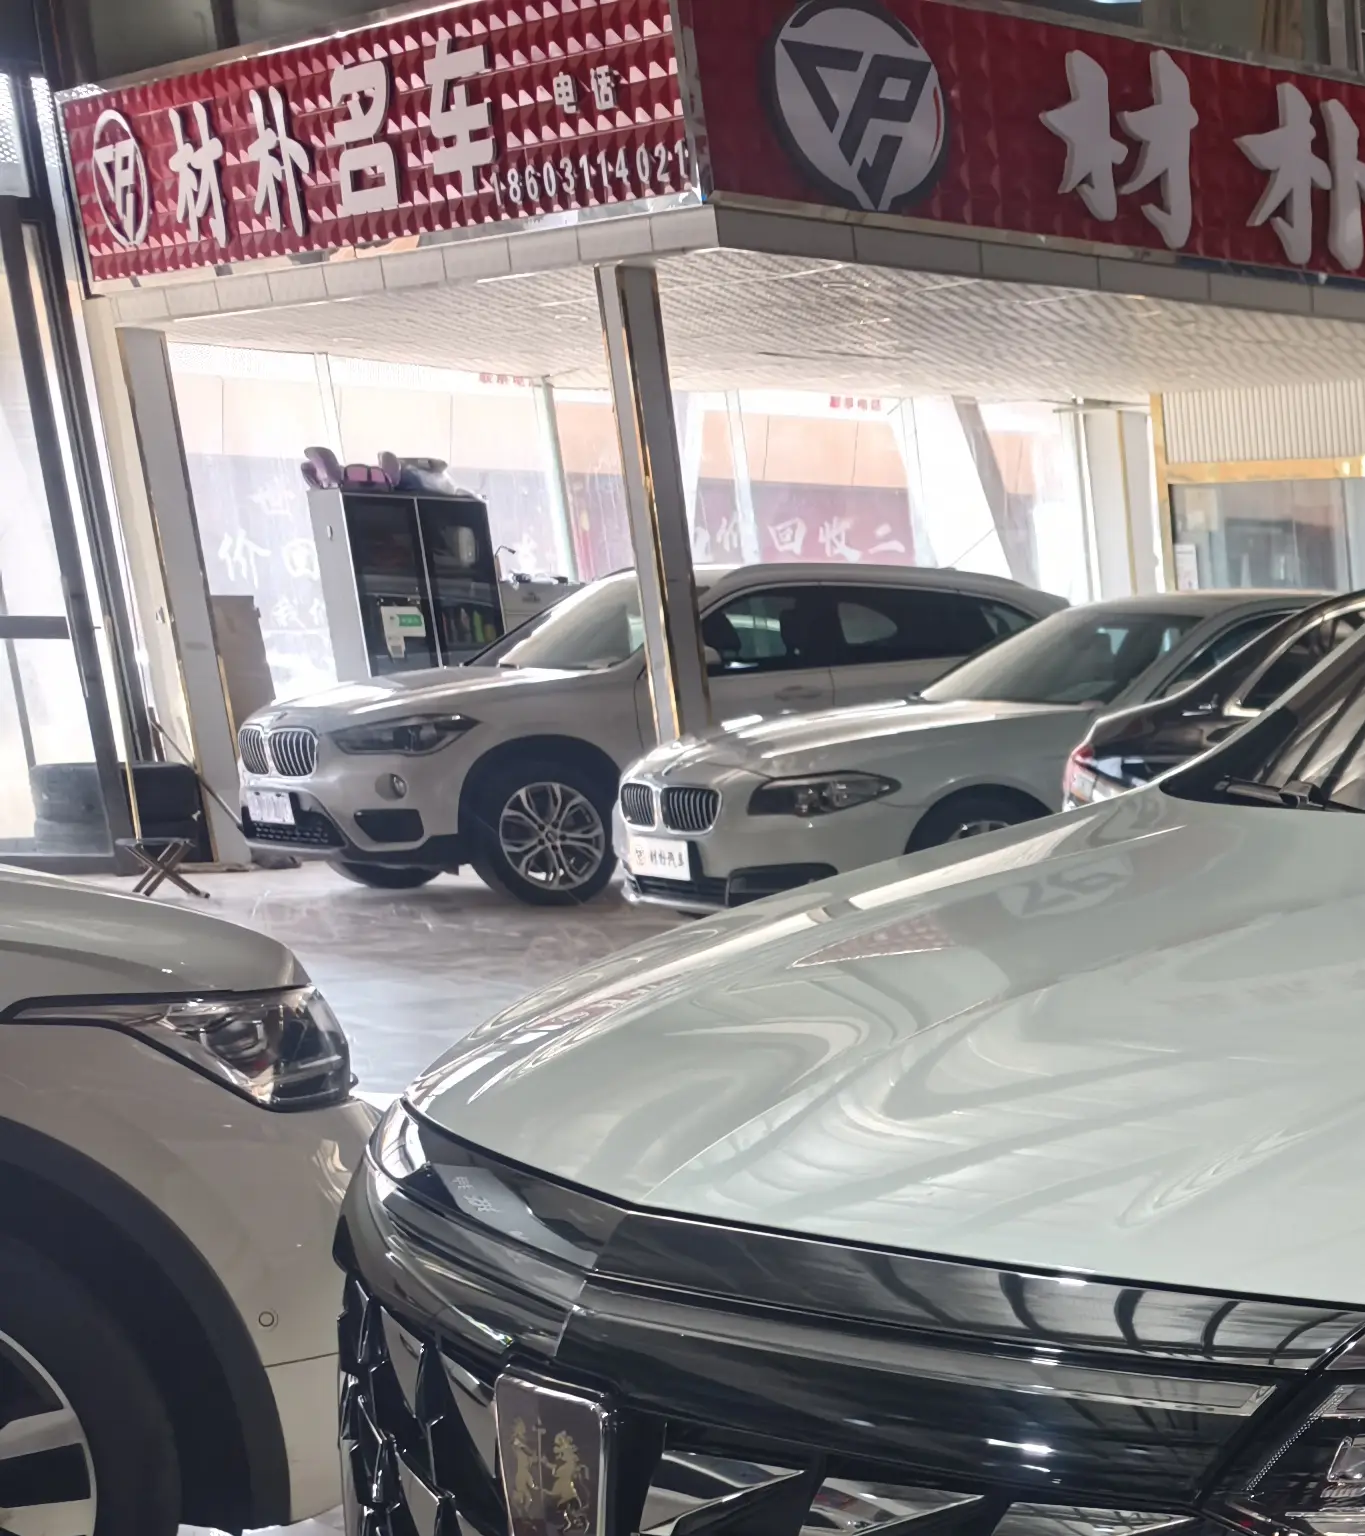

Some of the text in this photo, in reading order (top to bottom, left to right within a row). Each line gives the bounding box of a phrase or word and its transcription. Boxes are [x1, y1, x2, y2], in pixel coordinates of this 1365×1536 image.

[552, 65, 617, 115] 电话
[168, 37, 497, 248] 材朴名车
[489, 139, 688, 207] 18603114021
